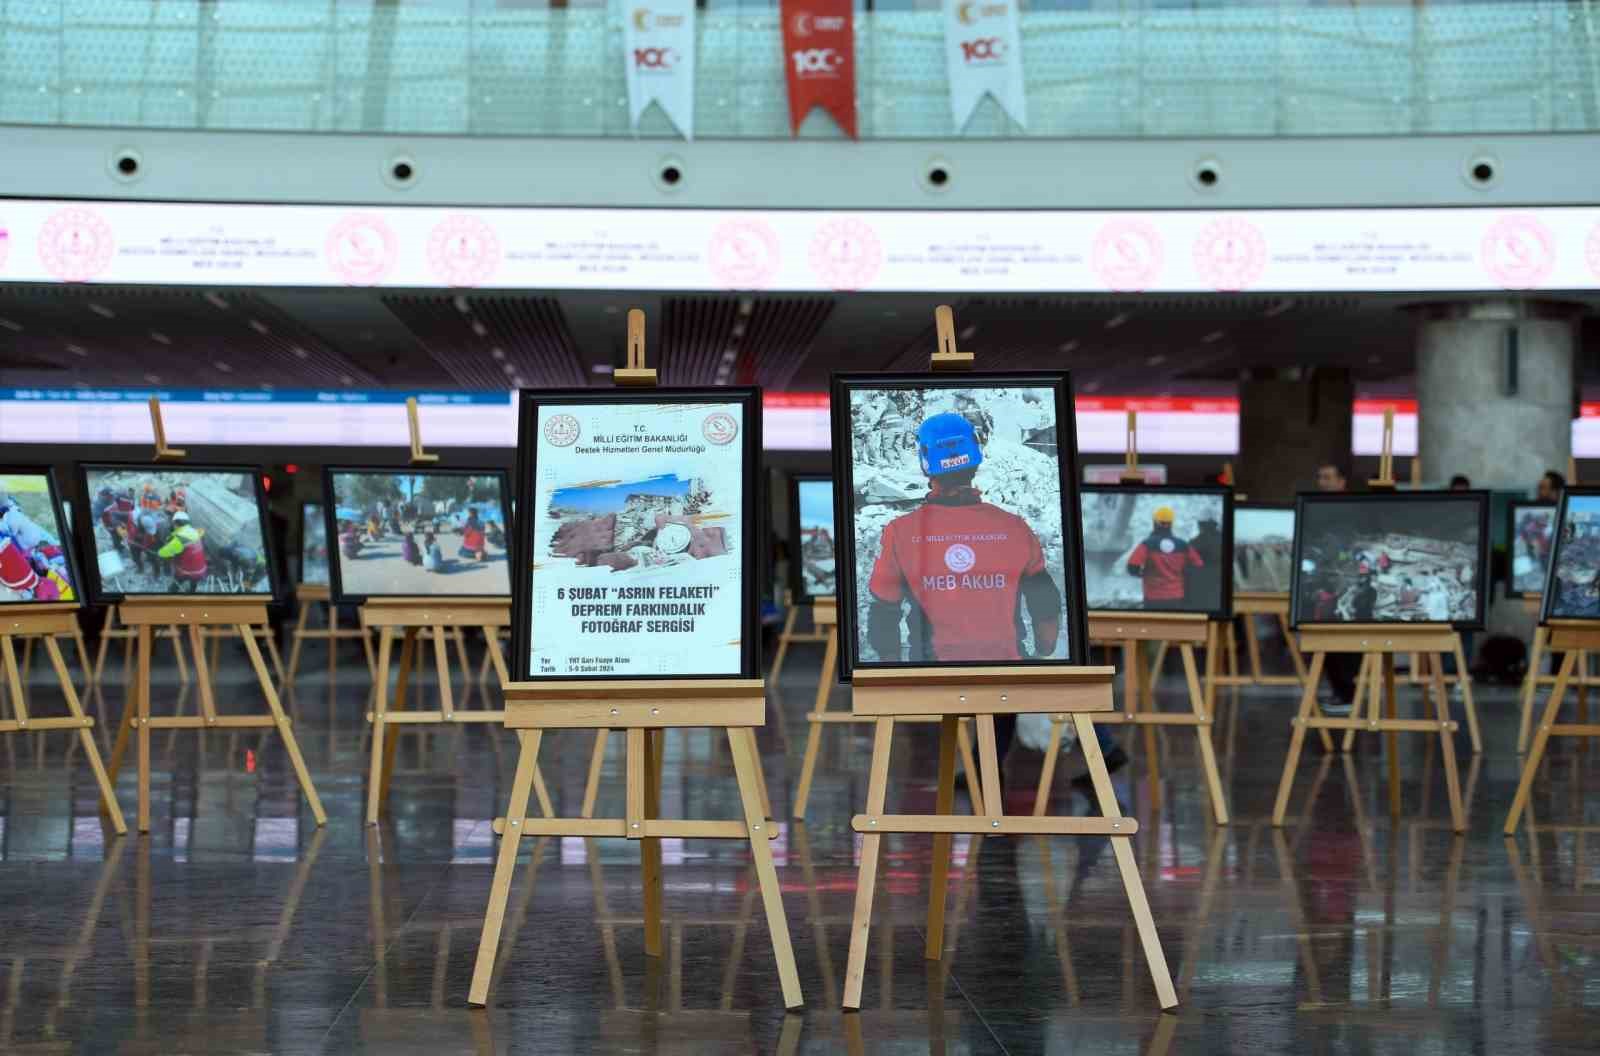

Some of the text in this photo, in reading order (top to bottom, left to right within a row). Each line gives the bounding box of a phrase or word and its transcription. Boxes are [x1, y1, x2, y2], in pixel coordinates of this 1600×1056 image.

[644, 434, 688, 442] BAKANLIĞI
[923, 574, 1005, 591] MEB AKUB
[557, 588, 565, 600] 6
[569, 587, 607, 600] ŞUBAT
[571, 603, 705, 616] DEPREM FARKINDALIK
[581, 618, 694, 633] FOTOĞRAF SERGİSİ
